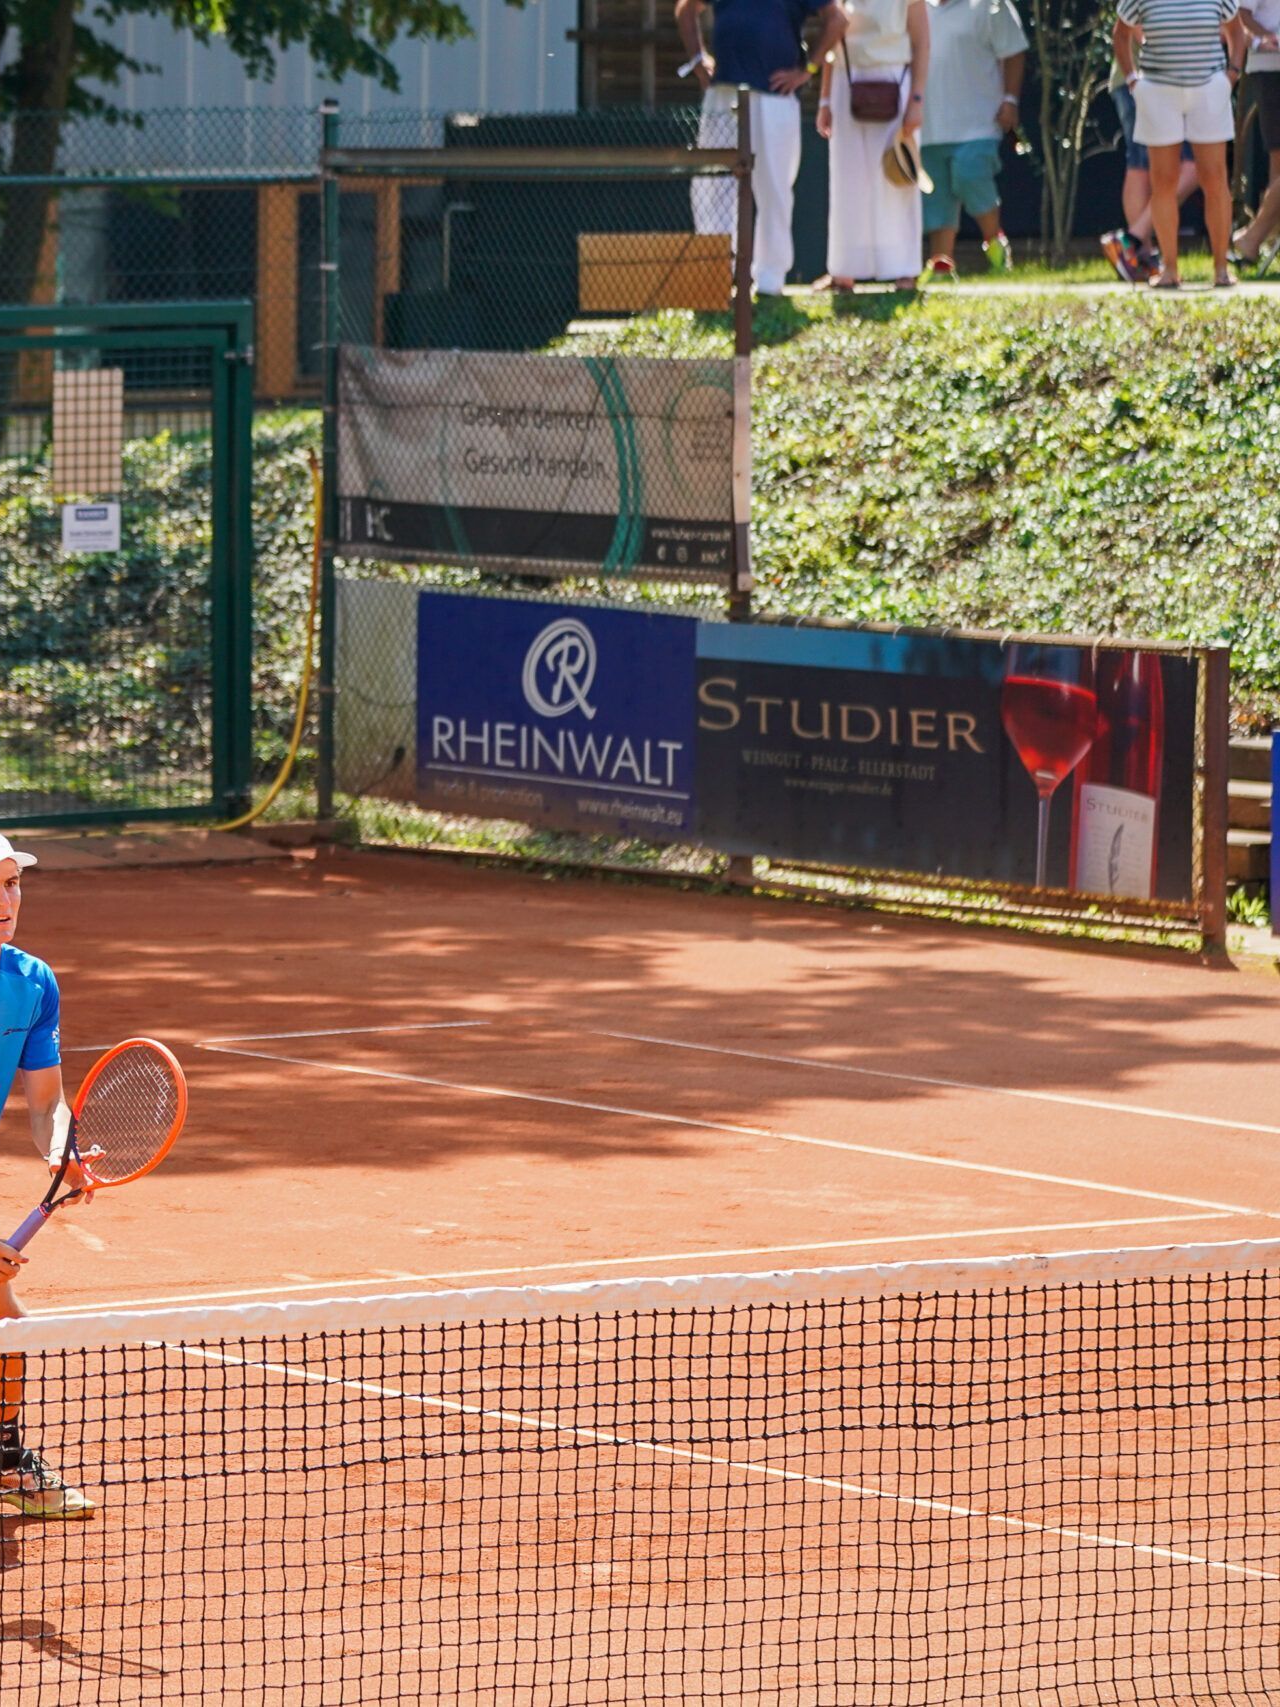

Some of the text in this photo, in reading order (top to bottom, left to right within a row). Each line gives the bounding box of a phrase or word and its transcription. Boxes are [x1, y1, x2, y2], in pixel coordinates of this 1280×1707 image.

[464, 448, 531, 476] Gesund
[698, 677, 985, 754] STUDIER
[432, 716, 683, 787] RHEINWALT
[741, 750, 936, 781] WEINGUT PFALZ ELLERSTADT
